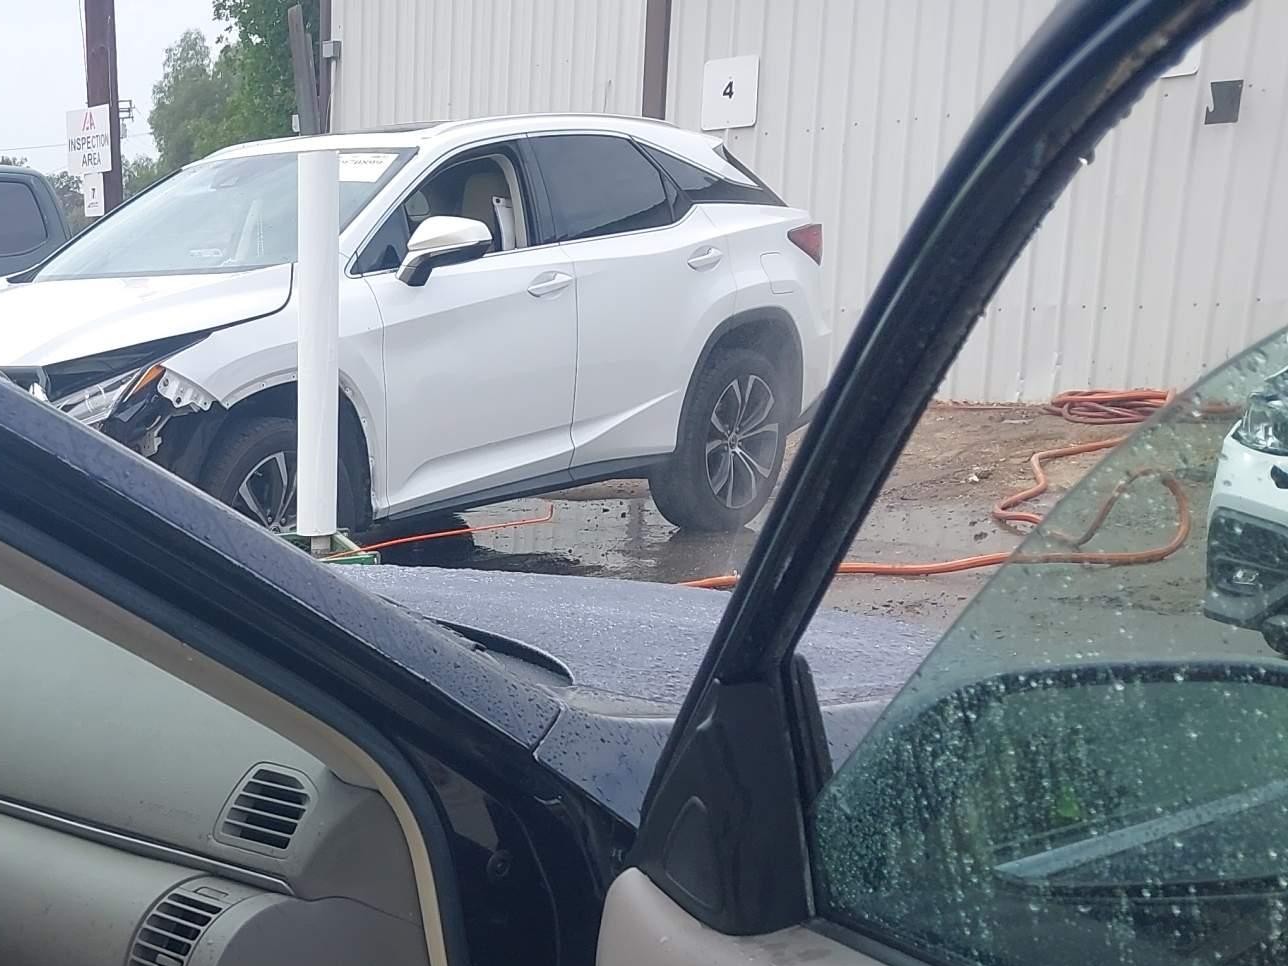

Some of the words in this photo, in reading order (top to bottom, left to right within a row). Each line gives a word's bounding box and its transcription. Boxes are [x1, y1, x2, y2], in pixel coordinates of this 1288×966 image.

[723, 81, 734, 99] 4
[68, 134, 110, 152] INSPECTION
[81, 152, 101, 167] AREA
[91, 187, 96, 199] 7
